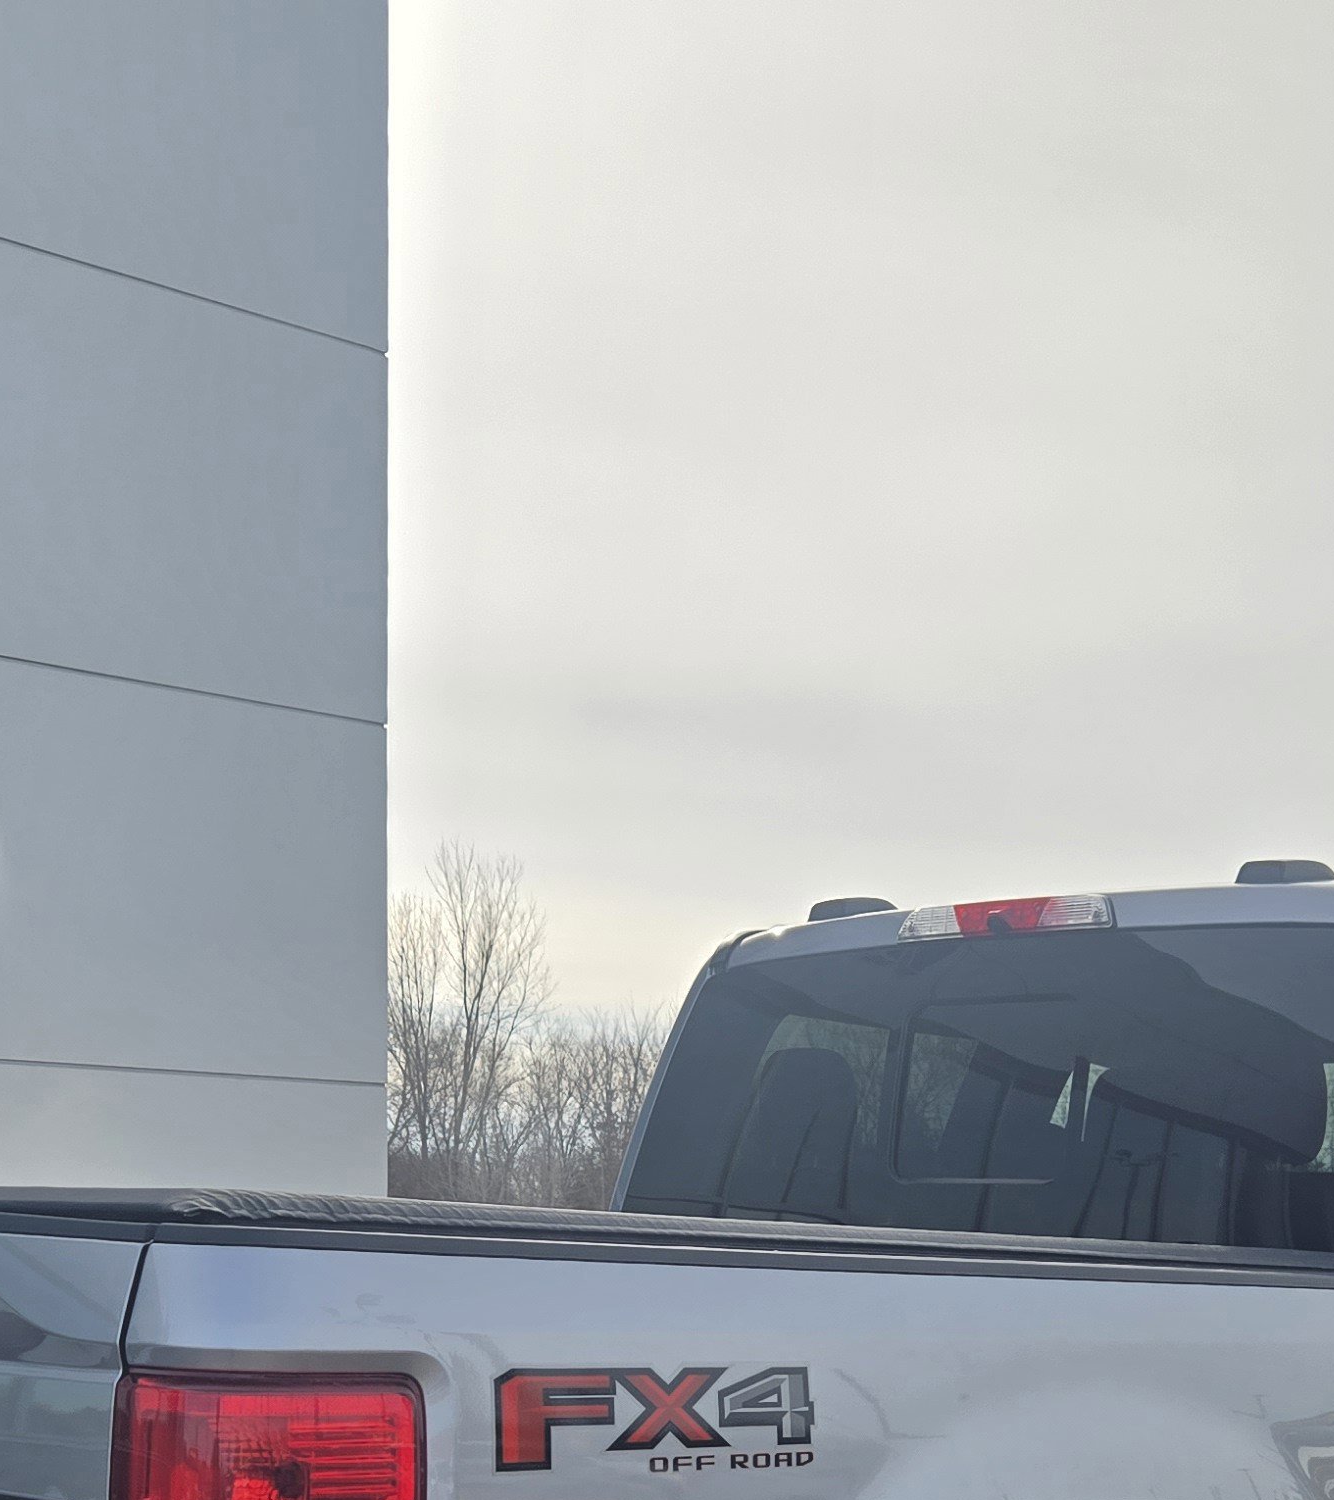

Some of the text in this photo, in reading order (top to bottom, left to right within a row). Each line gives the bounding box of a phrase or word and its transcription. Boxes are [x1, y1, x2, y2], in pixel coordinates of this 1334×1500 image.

[493, 1366, 815, 1473] FX4
[649, 1451, 814, 1473] OFF ROAD
